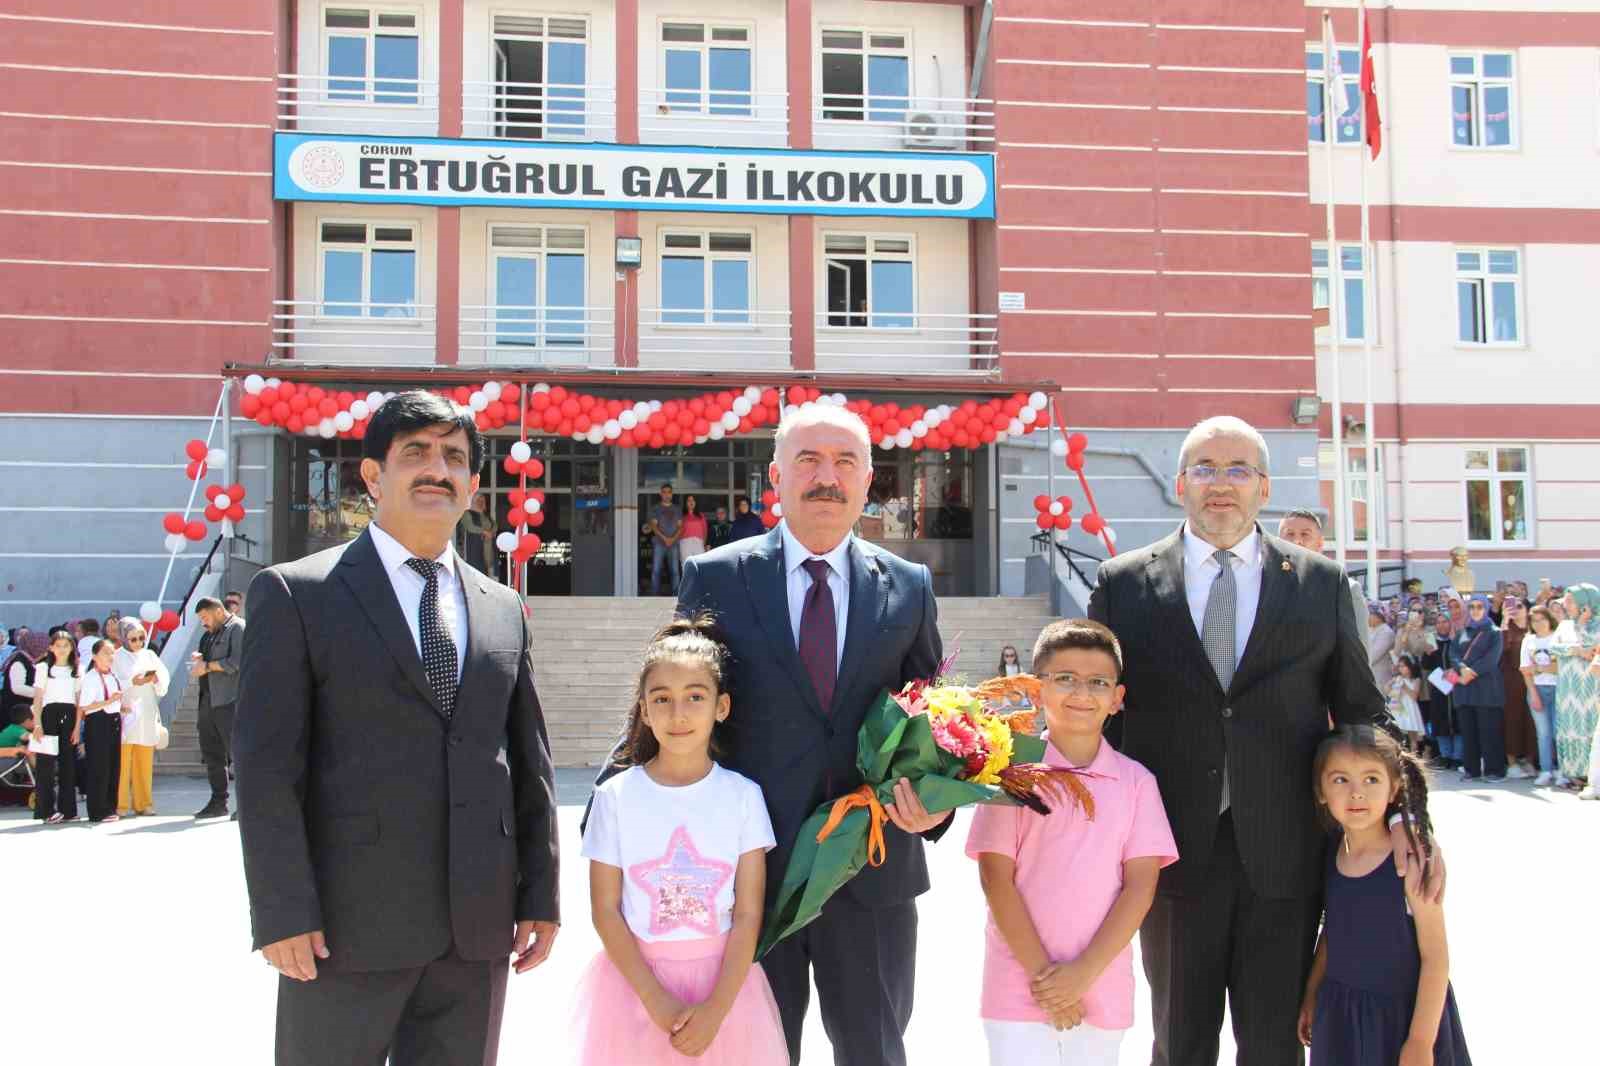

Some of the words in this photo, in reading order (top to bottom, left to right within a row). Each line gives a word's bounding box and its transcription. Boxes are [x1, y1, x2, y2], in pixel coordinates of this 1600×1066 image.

[359, 155, 605, 196] ERTUĞRUL
[621, 162, 727, 200] GAZİ
[746, 163, 963, 205] İLKOKULU
